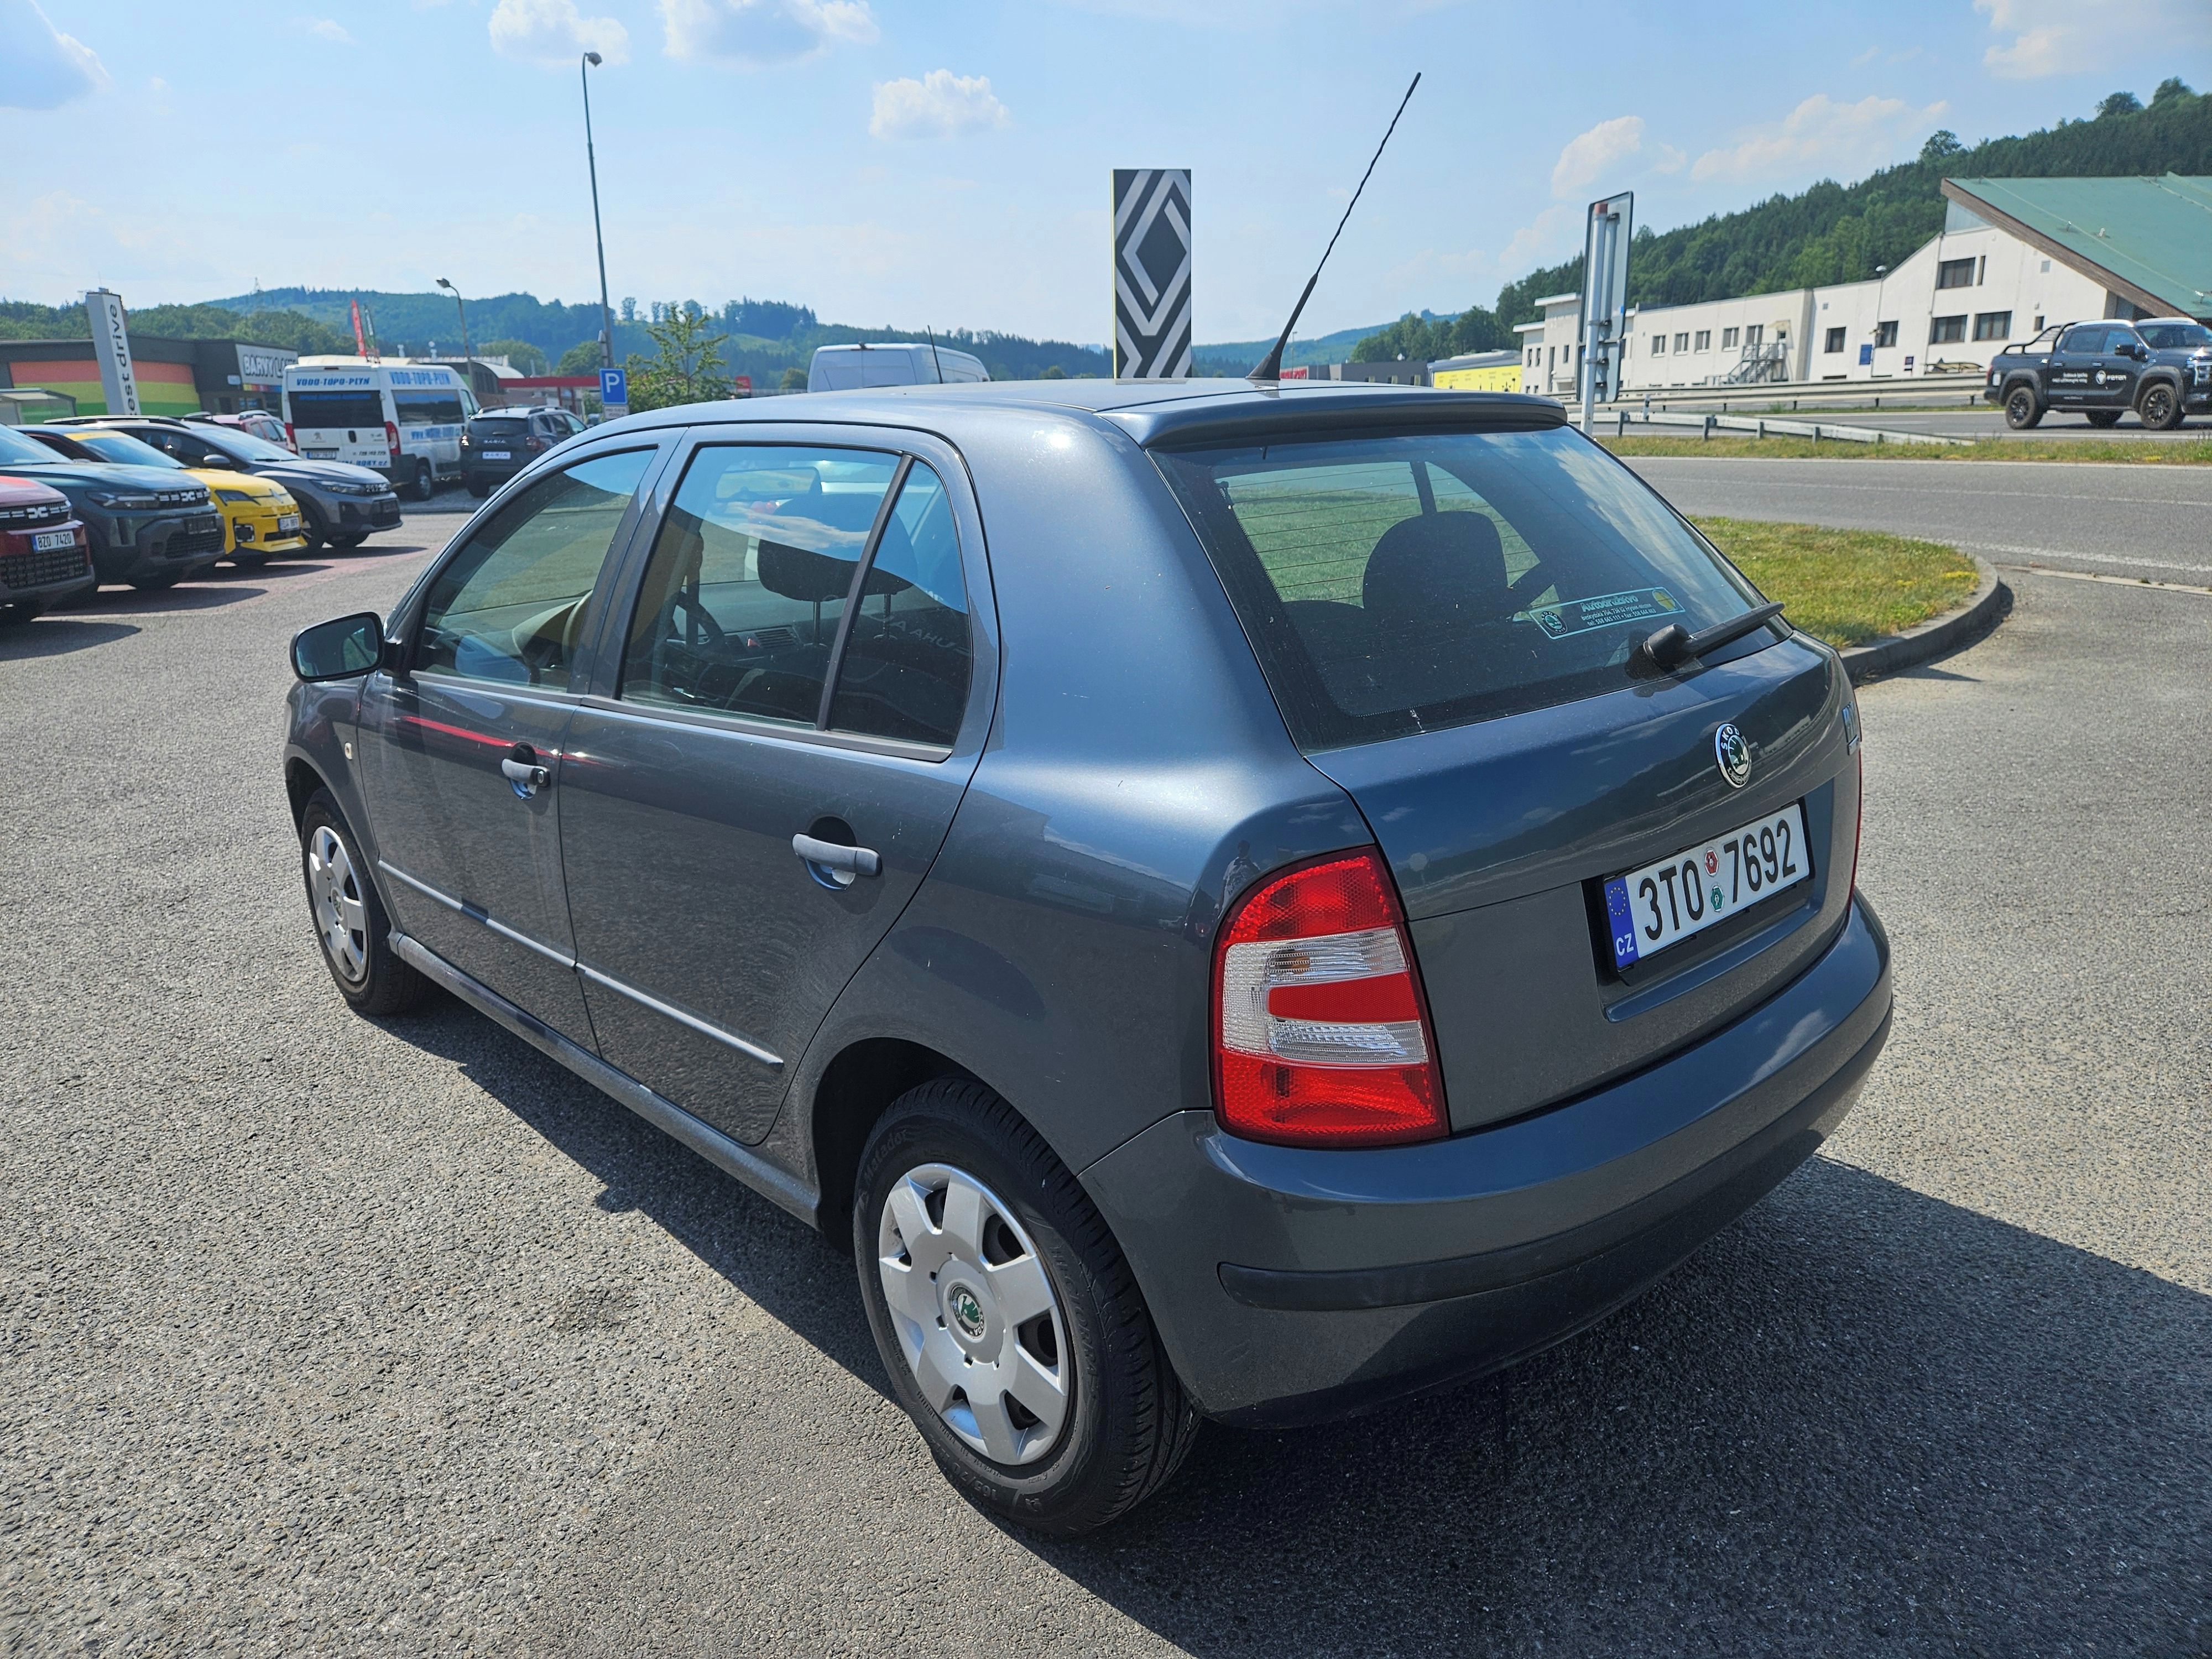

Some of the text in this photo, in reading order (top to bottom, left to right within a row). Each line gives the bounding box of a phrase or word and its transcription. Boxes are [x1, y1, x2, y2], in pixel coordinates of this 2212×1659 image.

[110, 305, 137, 415] est drive
[243, 354, 274, 377] BARVY
[605, 373, 619, 393] P
[55, 533, 72, 546] 7420
[1639, 820, 1797, 941] 3T0 7692
[1616, 933, 1634, 957] CZ
